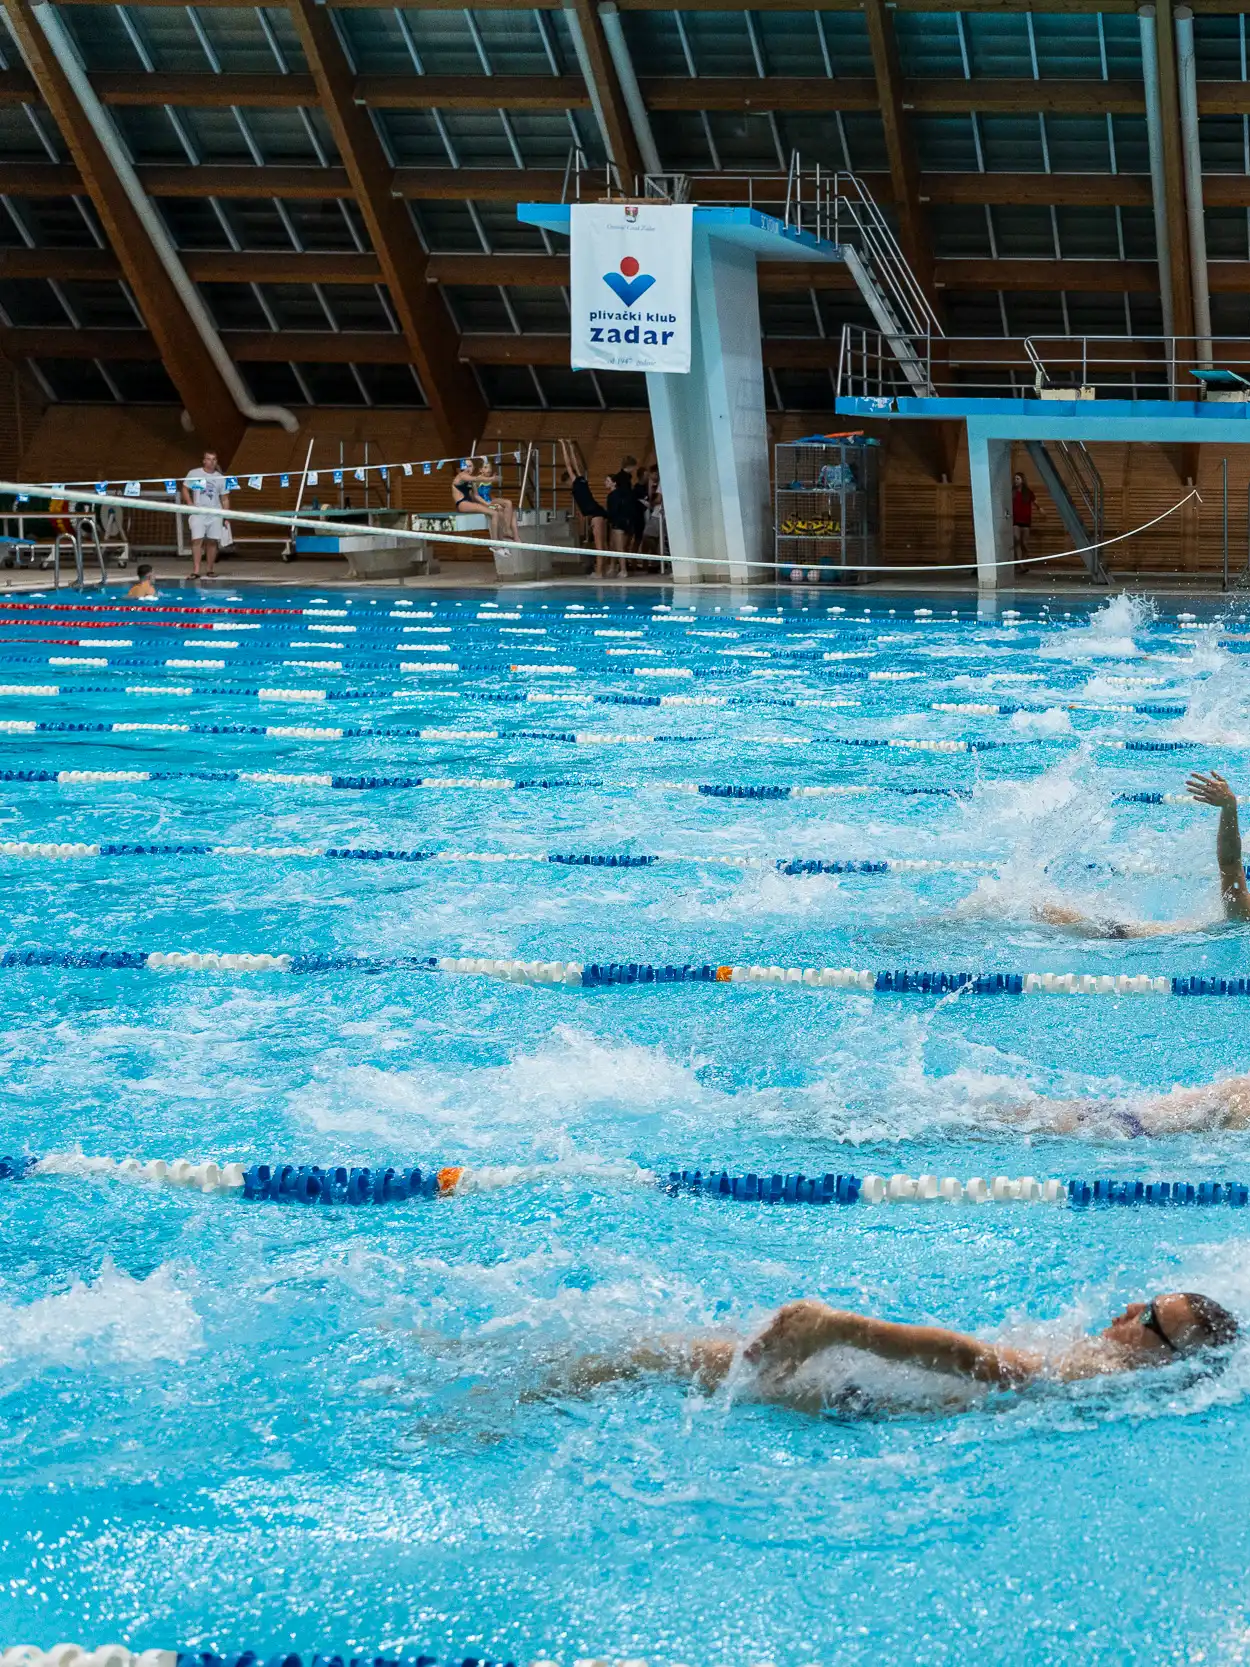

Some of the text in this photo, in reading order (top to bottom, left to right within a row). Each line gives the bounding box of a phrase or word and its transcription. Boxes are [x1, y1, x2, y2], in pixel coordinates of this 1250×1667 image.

[589, 310, 677, 323] plivački klub
[590, 325, 675, 346] zadar
